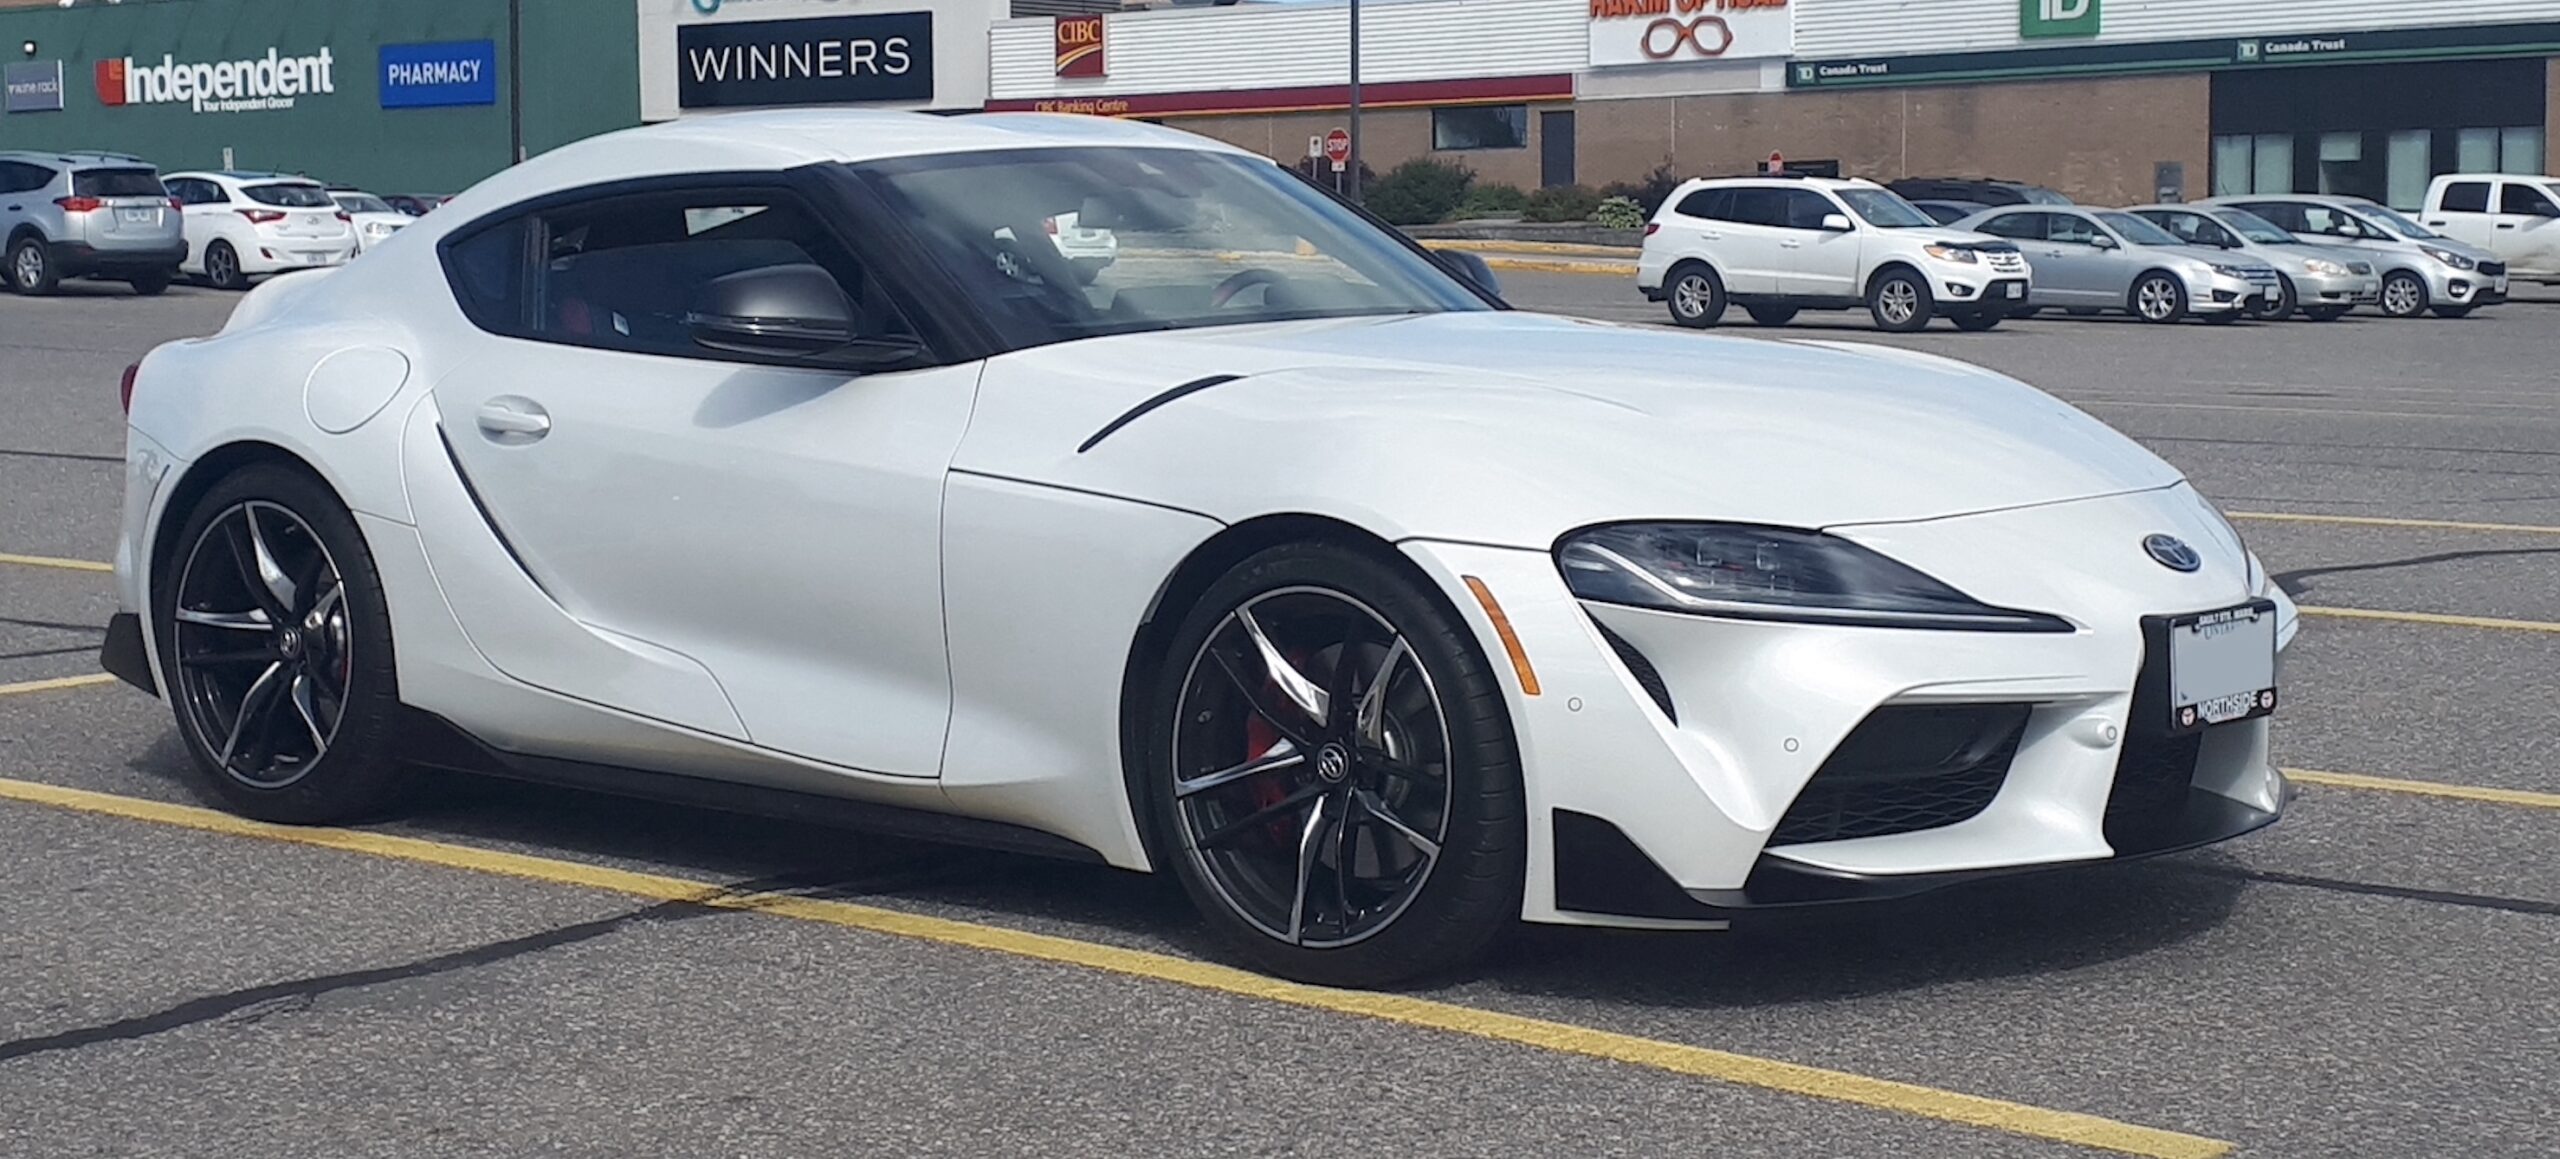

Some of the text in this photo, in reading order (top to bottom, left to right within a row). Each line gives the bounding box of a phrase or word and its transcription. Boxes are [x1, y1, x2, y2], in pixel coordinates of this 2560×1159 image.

[1058, 19, 1100, 43] CIBC
[2241, 39, 2345, 56] TD Canada Trust
[689, 37, 911, 82] WINNERS
[387, 59, 481, 86] PHARMACY
[1799, 63, 1888, 79] TD Canada Trust
[38, 76, 58, 92] rack
[124, 47, 333, 113] Independent
[202, 97, 295, 113] Your Independent Grocer
[1058, 99, 1094, 115] Banking
[1096, 99, 1128, 112] Centre
[1328, 138, 1348, 151] STOP
[2197, 690, 2258, 718] NORTHSIDE
